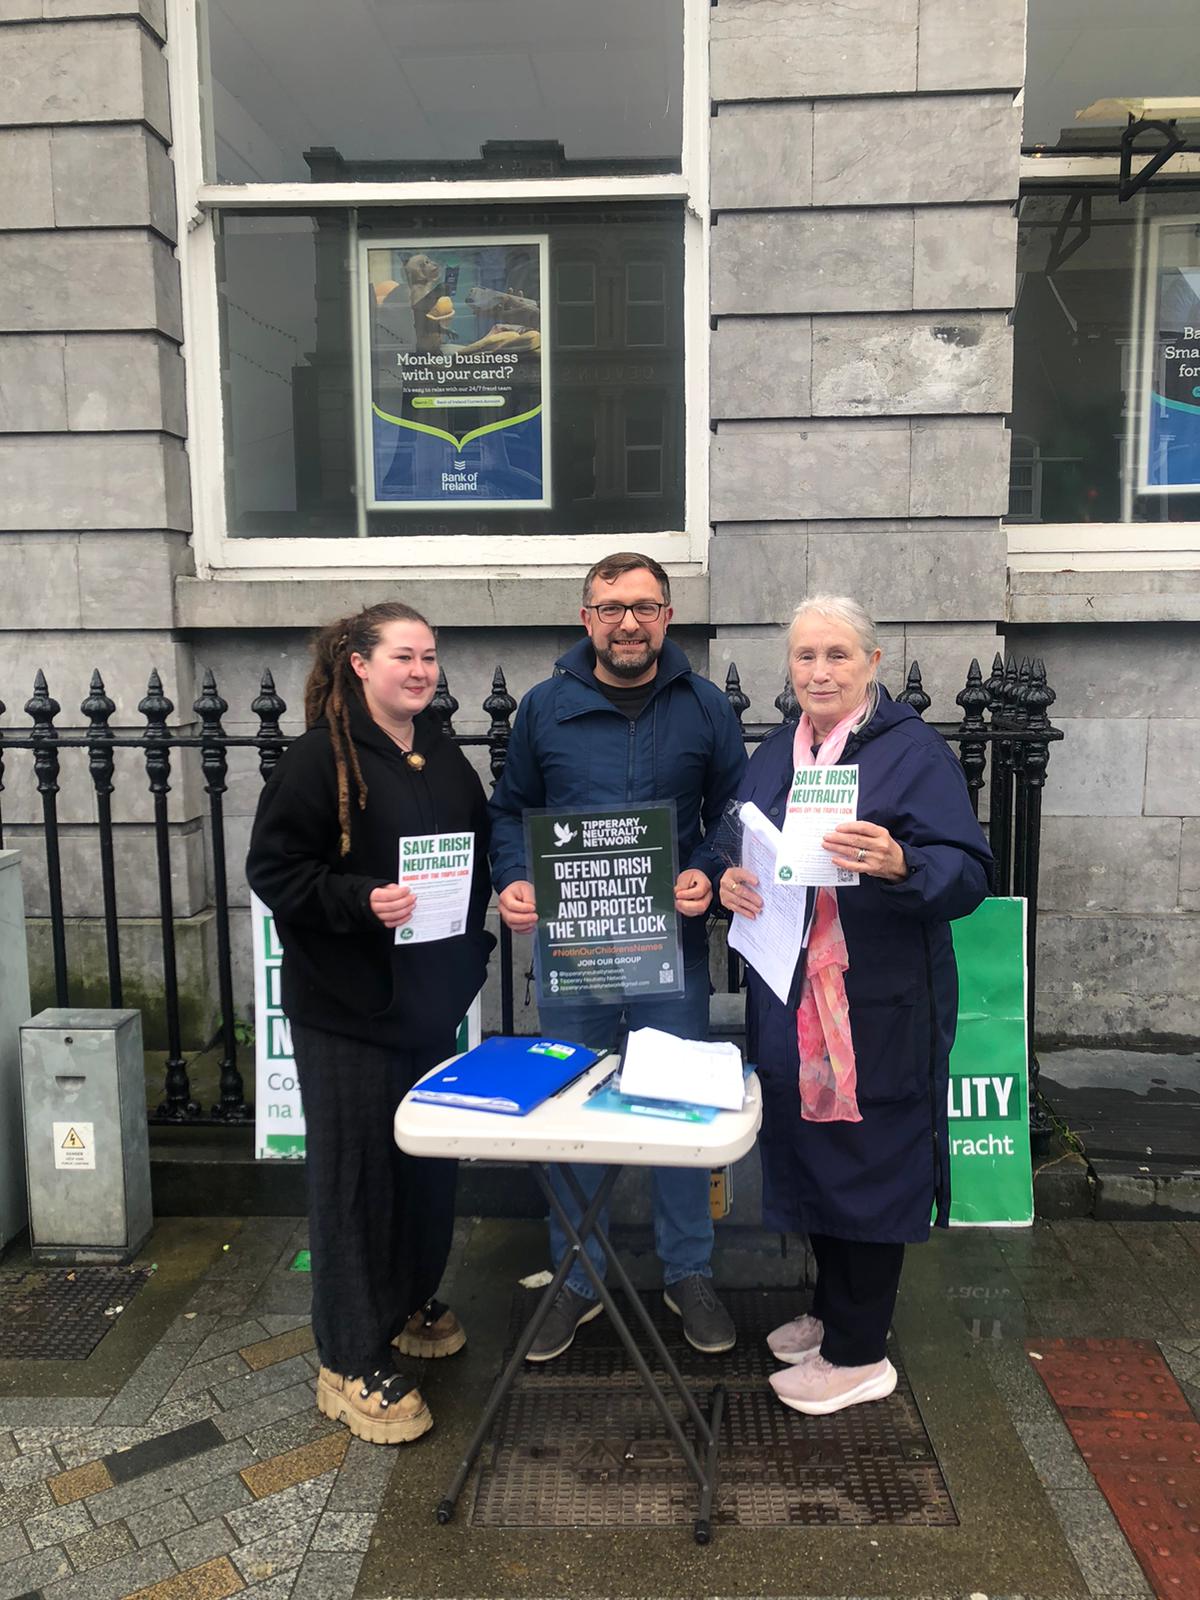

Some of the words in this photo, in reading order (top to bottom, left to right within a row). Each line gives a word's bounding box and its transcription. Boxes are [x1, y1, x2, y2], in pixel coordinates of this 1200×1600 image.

[396, 352, 453, 368] Monkey
[455, 351, 518, 364] business
[402, 368, 434, 381] with
[437, 371, 470, 383] your
[473, 366, 514, 379] card?
[442, 472, 466, 482] Bank
[467, 472, 478, 482] of
[442, 482, 477, 491] Ireland
[794, 770, 822, 785] SAVE
[825, 769, 857, 785] IRISH
[791, 789, 854, 803] NEUTRALITY
[581, 817, 640, 830] TIPPERARY
[582, 825, 648, 838] NEUTRALITY
[403, 839, 435, 856] SAVE
[438, 836, 471, 852] IRISH
[583, 835, 639, 848] NETWORK
[402, 854, 469, 872] NEUTRALITY
[554, 859, 610, 880] DEFEND
[613, 856, 652, 876] IRISH
[561, 876, 647, 899] NEUTRALITY
[558, 901, 587, 919] AND
[590, 896, 653, 917] PROTECT
[546, 921, 575, 939] THE
[577, 917, 627, 938] TRIPLE
[630, 914, 667, 934] LOCK
[577, 958, 596, 967] JOIN
[596, 957, 613, 966] OUR
[614, 956, 641, 965] GROUP
[268, 1103, 292, 1118] na
[948, 1133, 1014, 1155] racht
